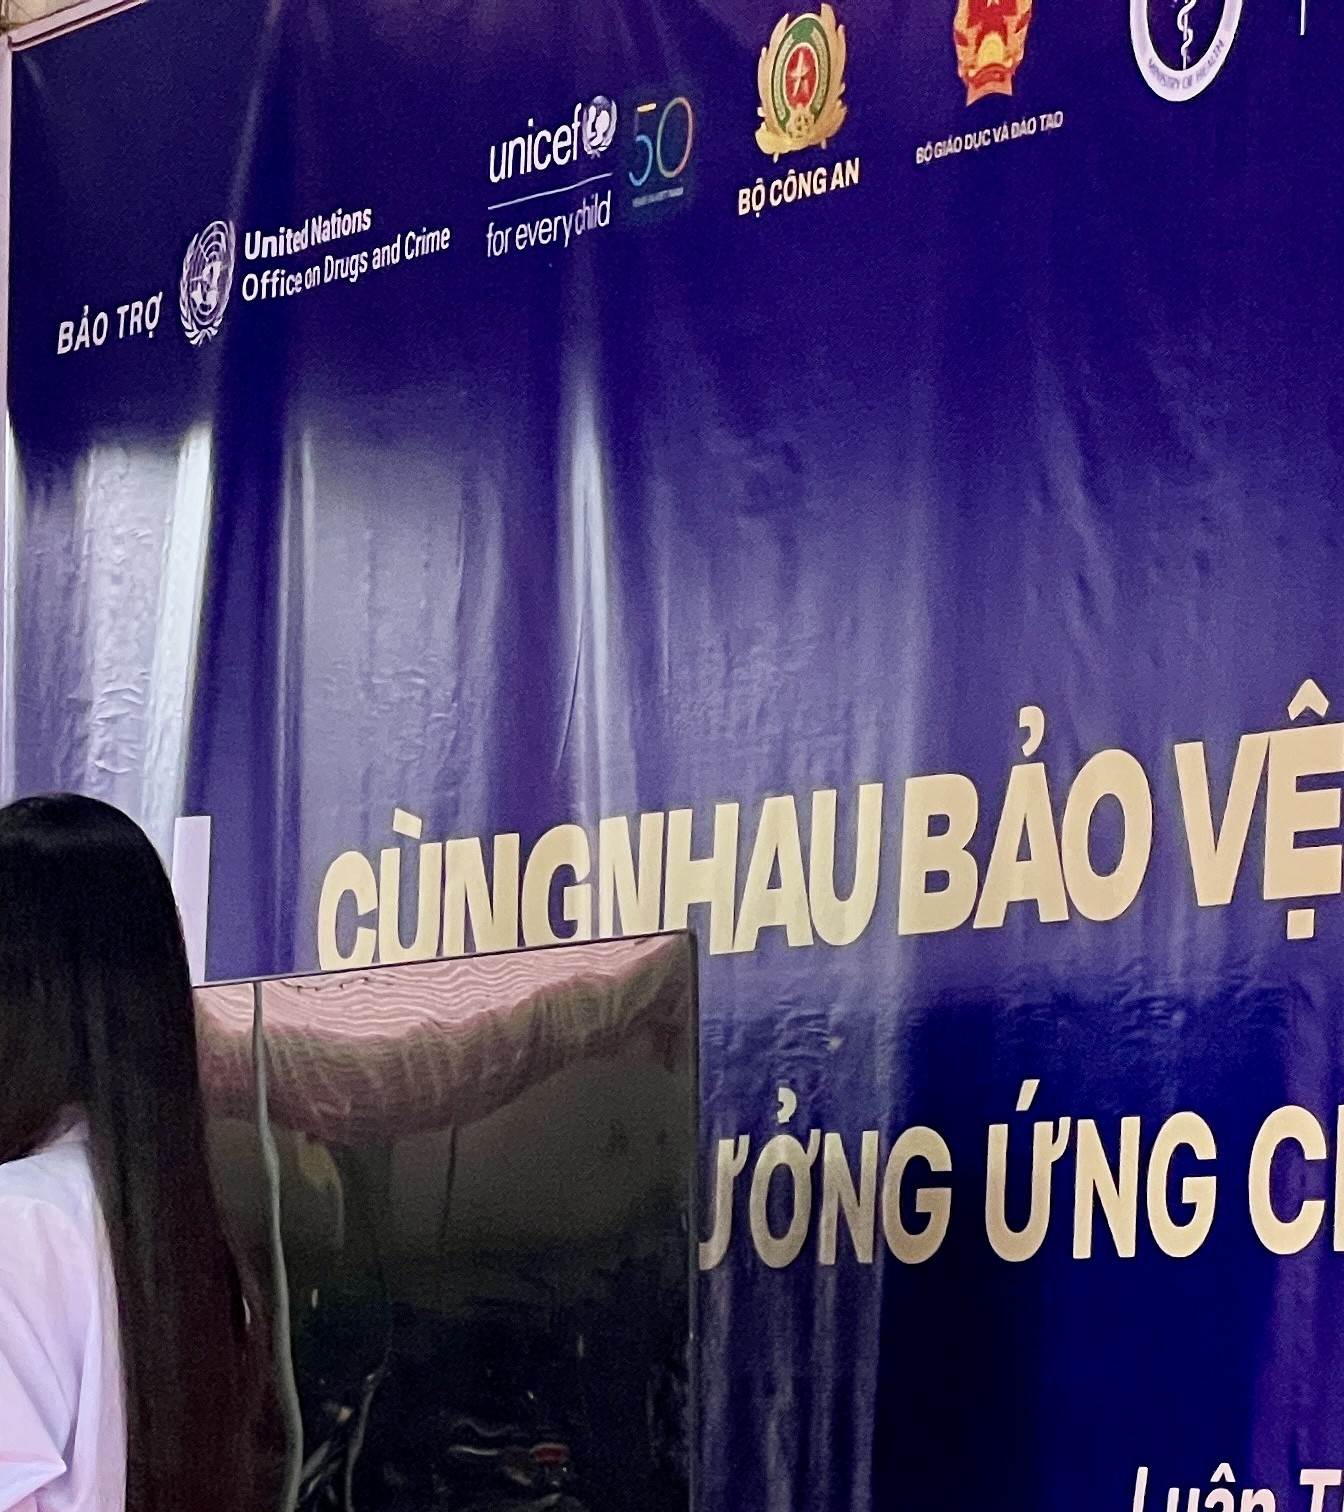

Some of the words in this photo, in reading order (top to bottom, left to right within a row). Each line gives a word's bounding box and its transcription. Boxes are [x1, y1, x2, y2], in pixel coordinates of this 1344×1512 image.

[489, 102, 582, 183] unicef
[629, 96, 694, 186] 50
[964, 129, 992, 151] DỤC
[486, 221, 512, 257] for
[515, 212, 575, 248] every
[574, 189, 611, 236] child
[738, 177, 765, 218] BỘ
[768, 169, 828, 207] CÔNG
[830, 157, 860, 191] AN
[242, 268, 303, 301] Office
[304, 264, 321, 288] on
[323, 251, 368, 284] Drugs
[372, 233, 400, 270] and
[404, 226, 451, 260] Crime
[244, 220, 308, 260] United
[311, 208, 373, 247] Nations
[56, 305, 109, 355] BẢO
[116, 291, 164, 339] TRỢ
[896, 705, 1154, 936] BẢO
[1173, 678, 1344, 941] VỆ
[699, 1079, 954, 1271] ƯỞNG
[985, 1079, 1217, 1262] ỨNG
